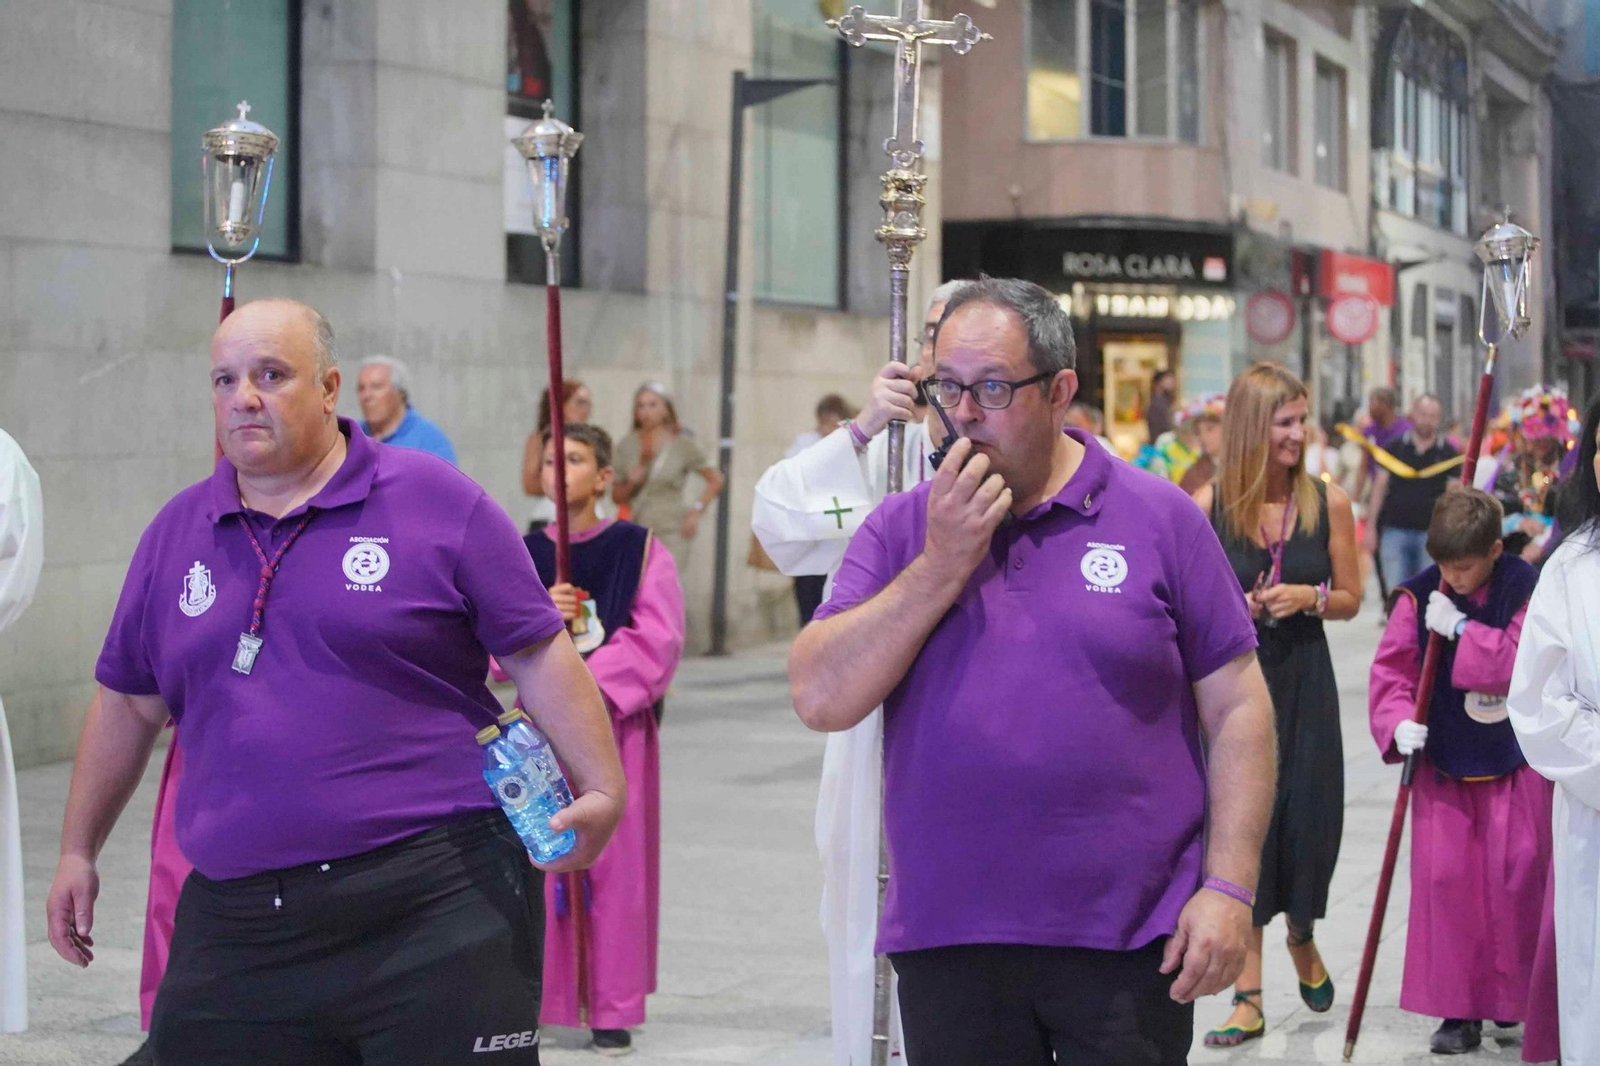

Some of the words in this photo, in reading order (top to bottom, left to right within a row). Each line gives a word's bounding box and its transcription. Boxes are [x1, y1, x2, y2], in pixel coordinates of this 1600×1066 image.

[1063, 251, 1122, 277] ROSA
[345, 583, 382, 592] VODEA
[1085, 584, 1121, 594] VODEA
